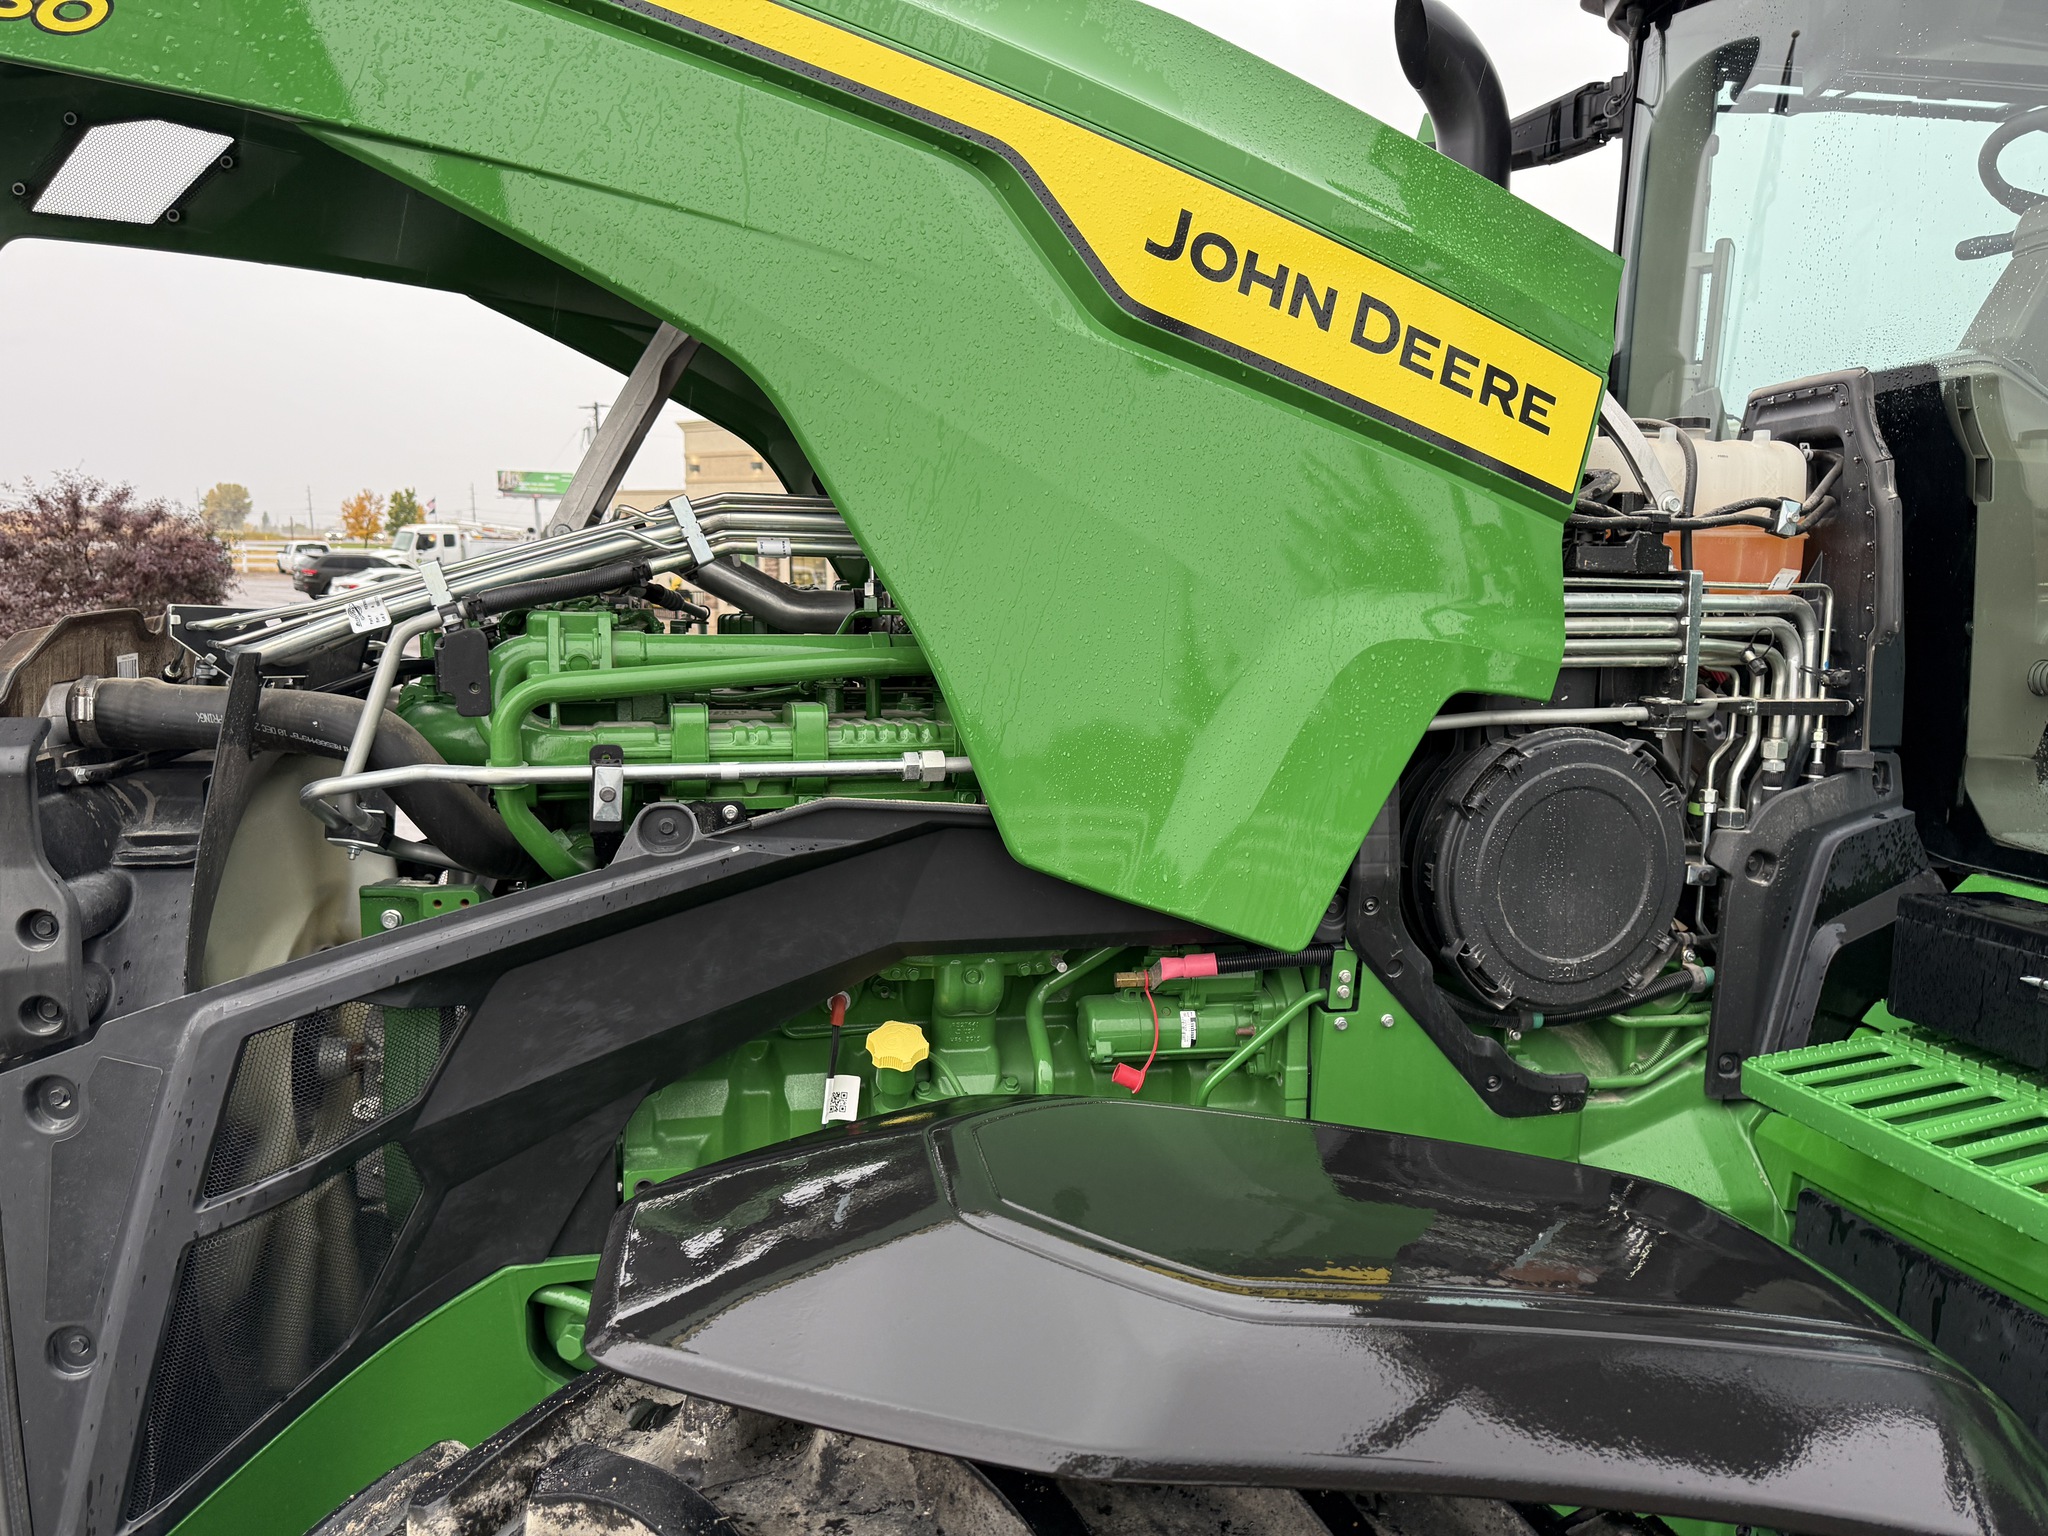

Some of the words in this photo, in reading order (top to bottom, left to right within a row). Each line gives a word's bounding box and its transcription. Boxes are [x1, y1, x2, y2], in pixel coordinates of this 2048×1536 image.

[1144, 208, 1338, 332] JOHN
[1350, 292, 1557, 436] DEERE
[261, 724, 277, 735] DEC
